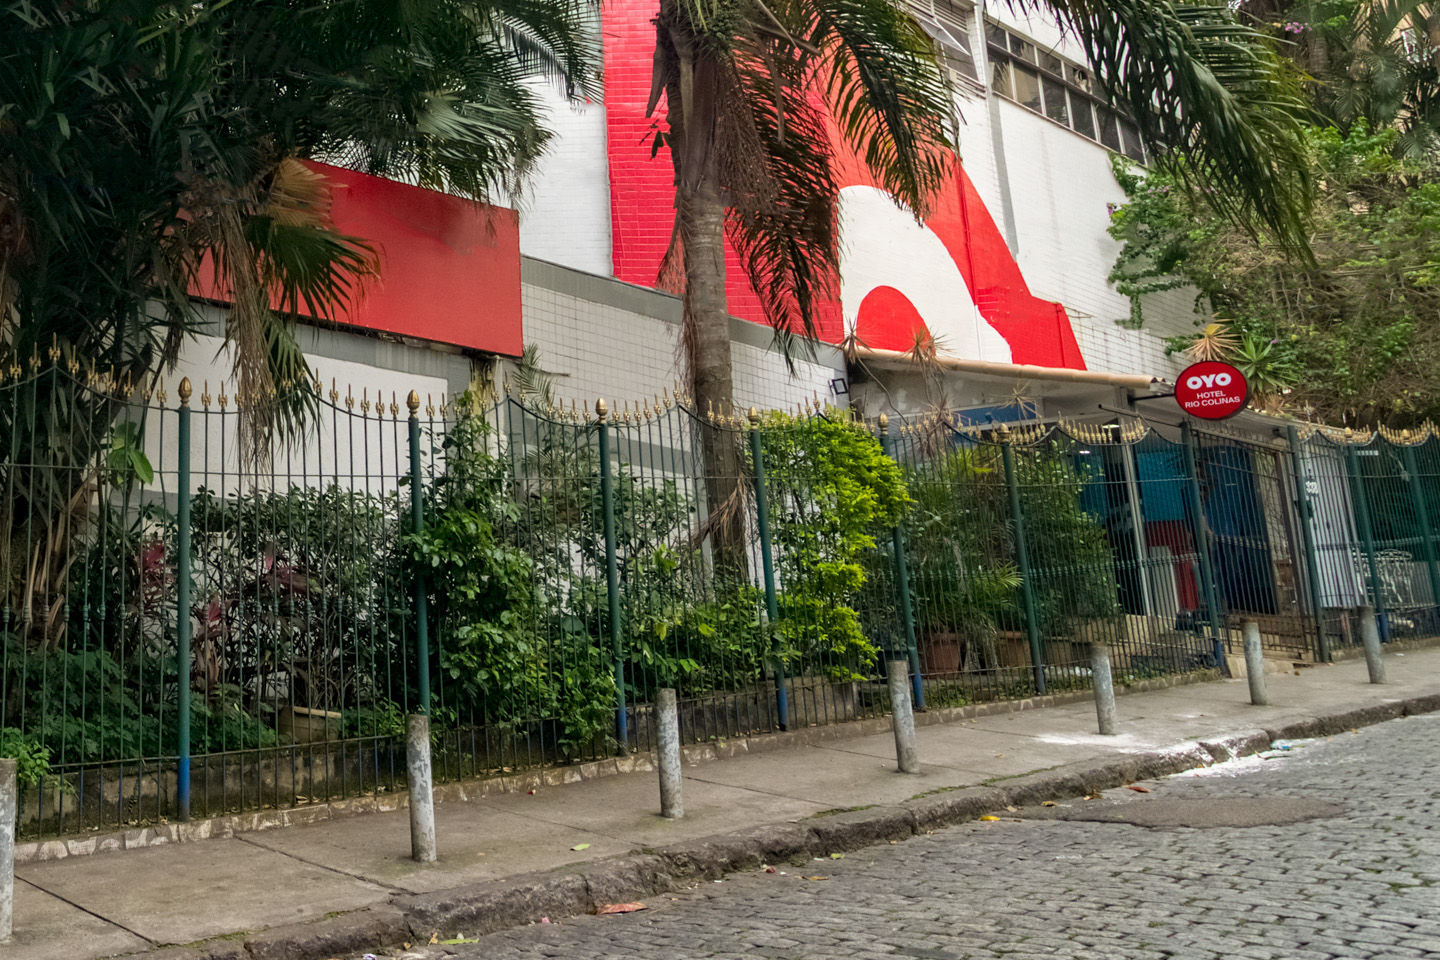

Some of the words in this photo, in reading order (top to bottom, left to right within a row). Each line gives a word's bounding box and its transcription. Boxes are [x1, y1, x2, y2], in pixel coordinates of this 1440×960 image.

[1186, 372, 1232, 390] OYO
[1196, 390, 1227, 399] HOTEL
[1184, 400, 1200, 408] RIO
[1201, 396, 1241, 406] COLINAS
